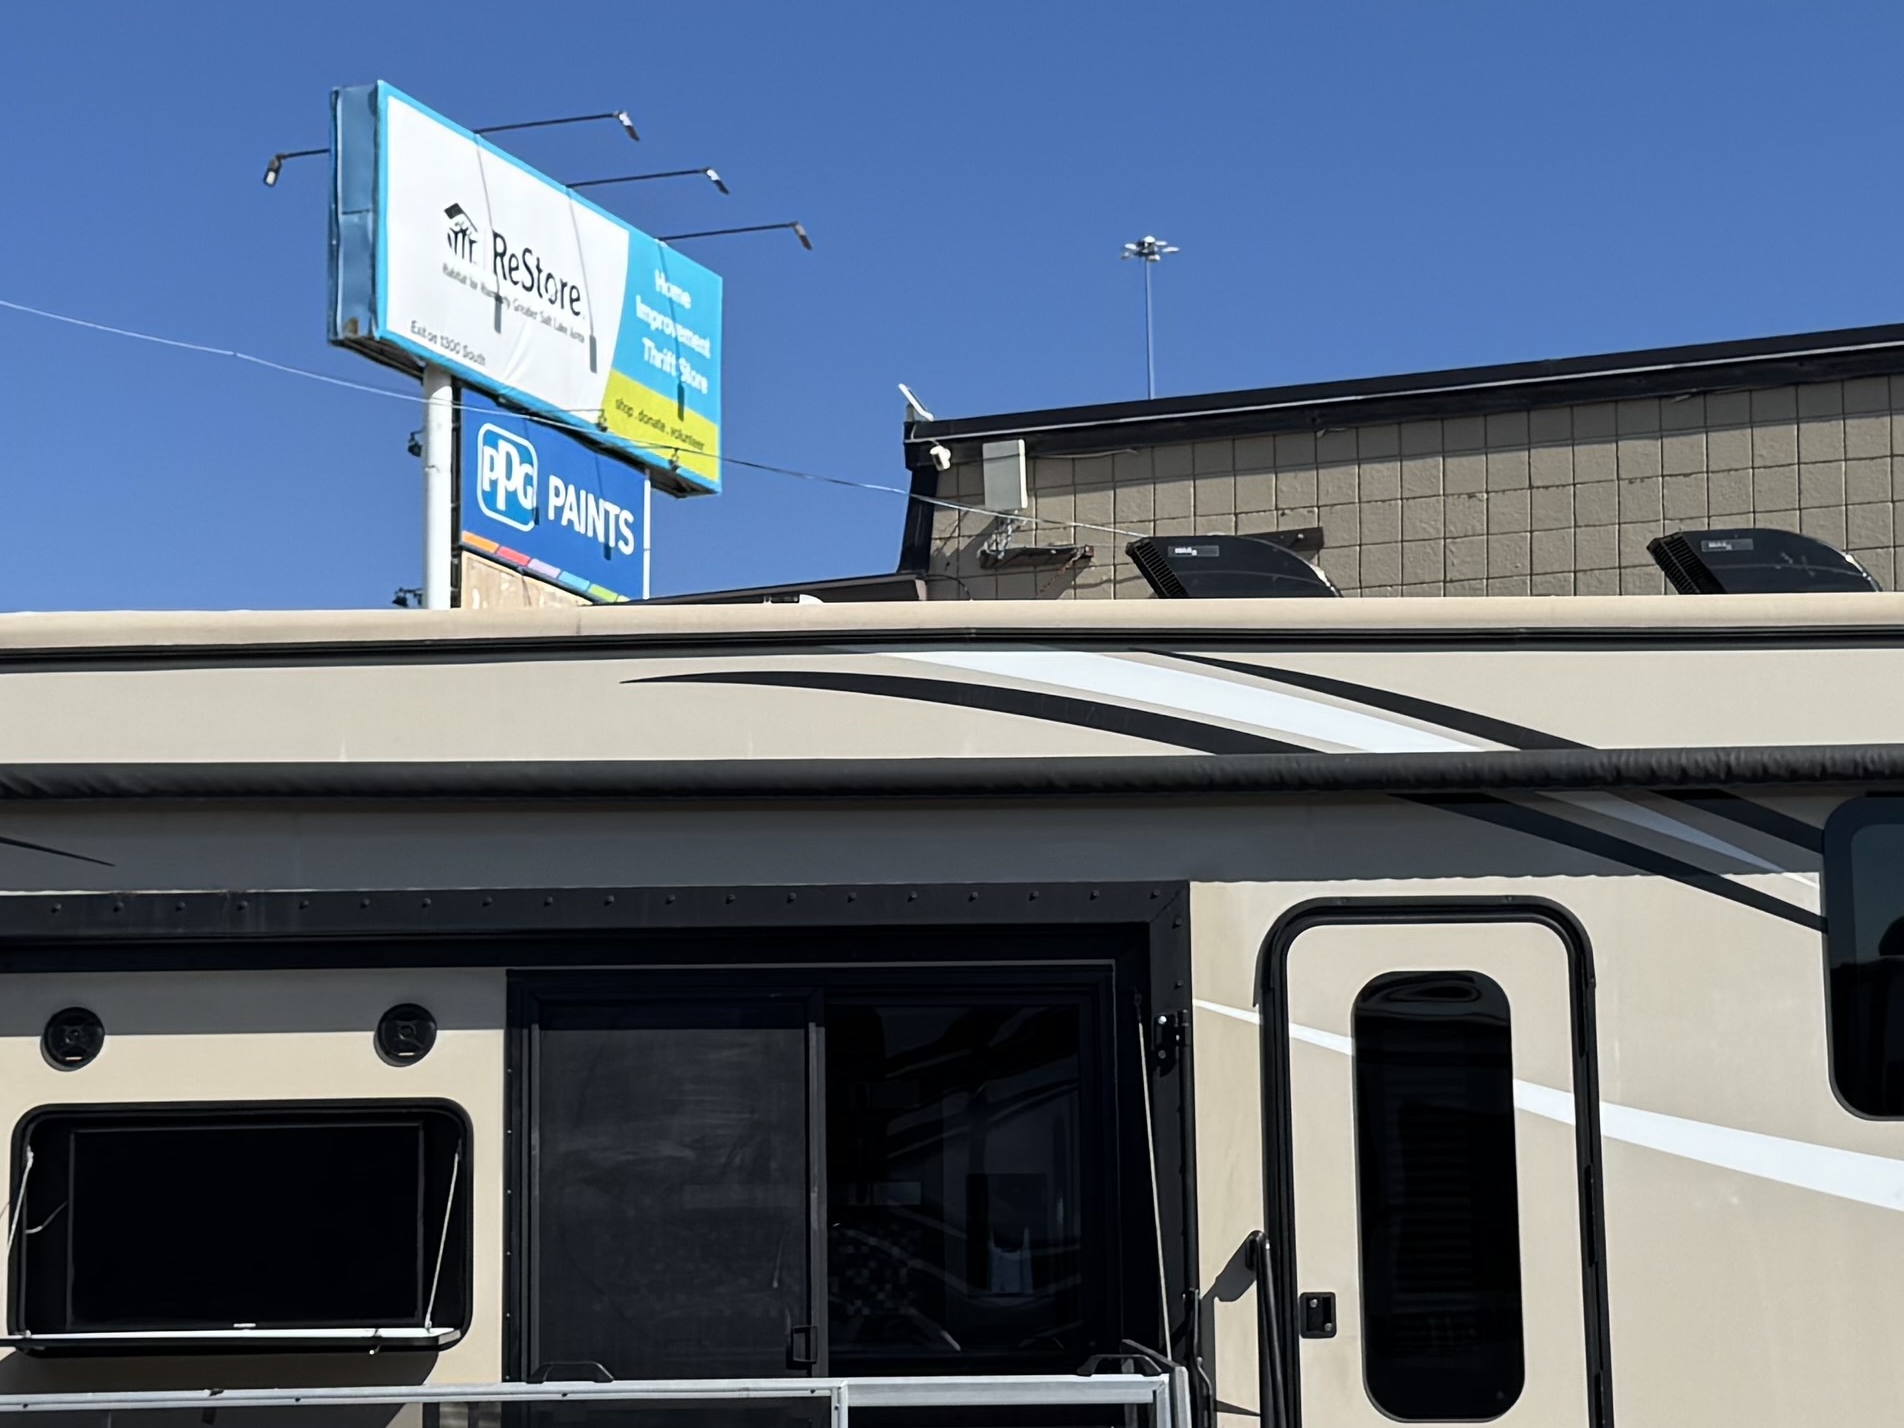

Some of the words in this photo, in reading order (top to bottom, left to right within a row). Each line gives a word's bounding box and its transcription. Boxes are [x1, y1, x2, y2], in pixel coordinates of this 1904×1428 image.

[492, 230, 581, 317] ReStore
[654, 268, 692, 310] Home
[636, 294, 711, 359] Improvement
[642, 337, 676, 377] Thrift
[678, 357, 709, 395] Store
[482, 438, 534, 512] PPG
[548, 474, 635, 556] PAINTS
